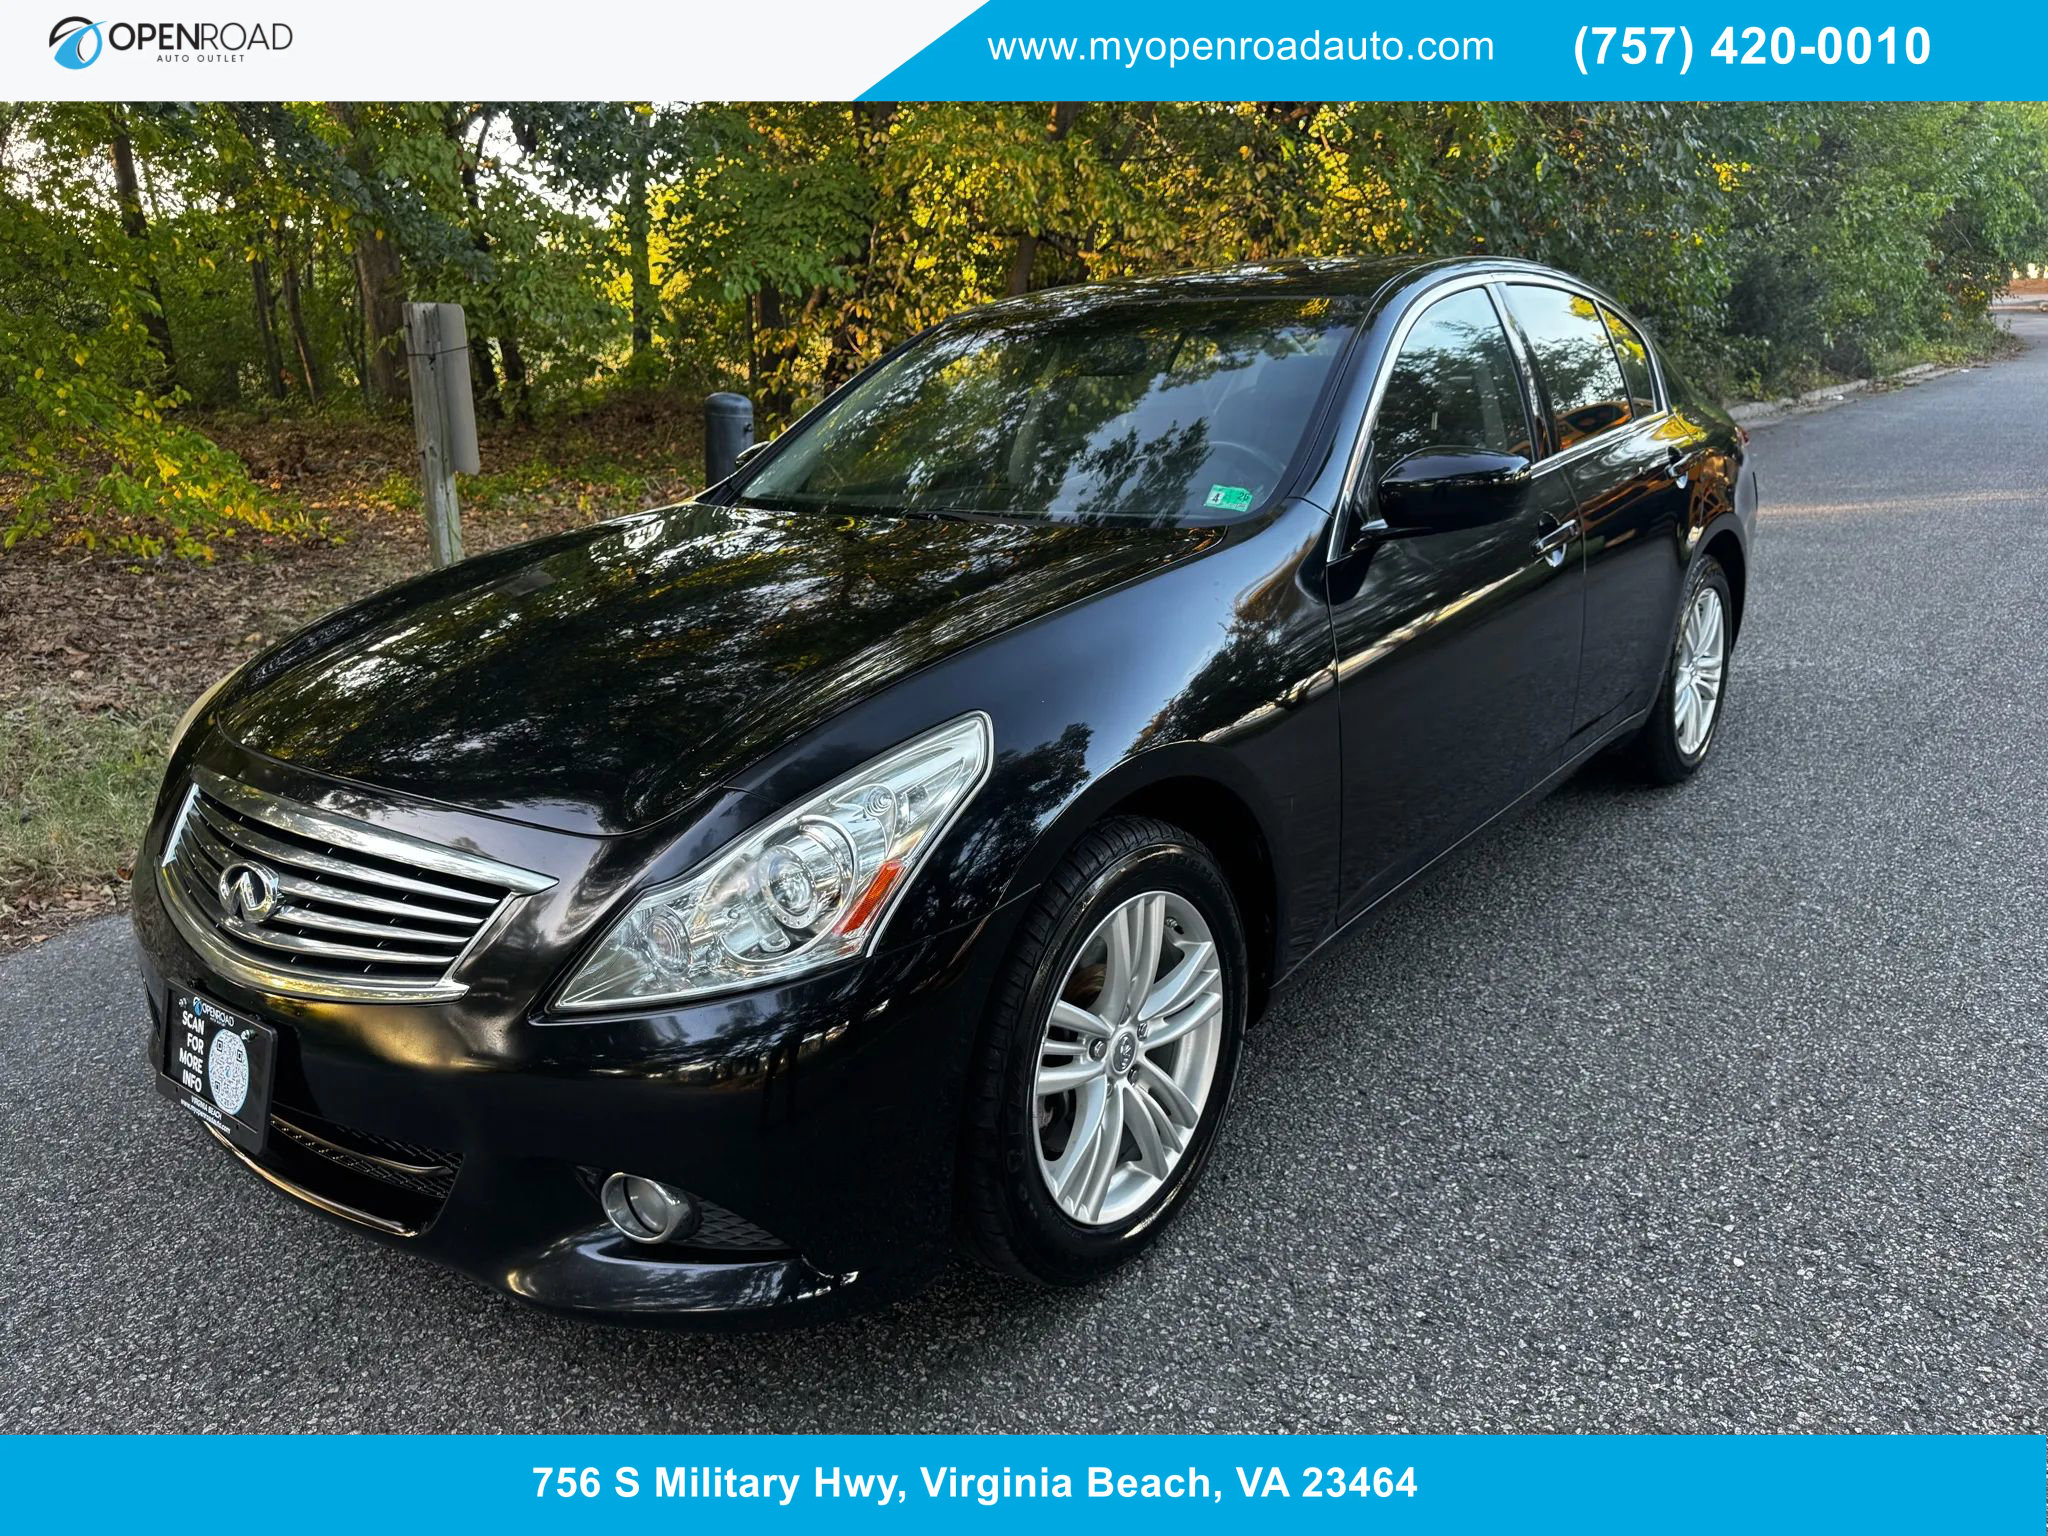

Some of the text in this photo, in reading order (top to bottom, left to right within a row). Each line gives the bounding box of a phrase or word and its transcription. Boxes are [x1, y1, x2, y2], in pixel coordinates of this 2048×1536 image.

[182, 1010, 205, 1035] SCAN
[202, 1002, 235, 1027] OPENROAD
[187, 1032, 204, 1055] FOR
[179, 1047, 203, 1074] MORE
[182, 1069, 202, 1093] INFO
